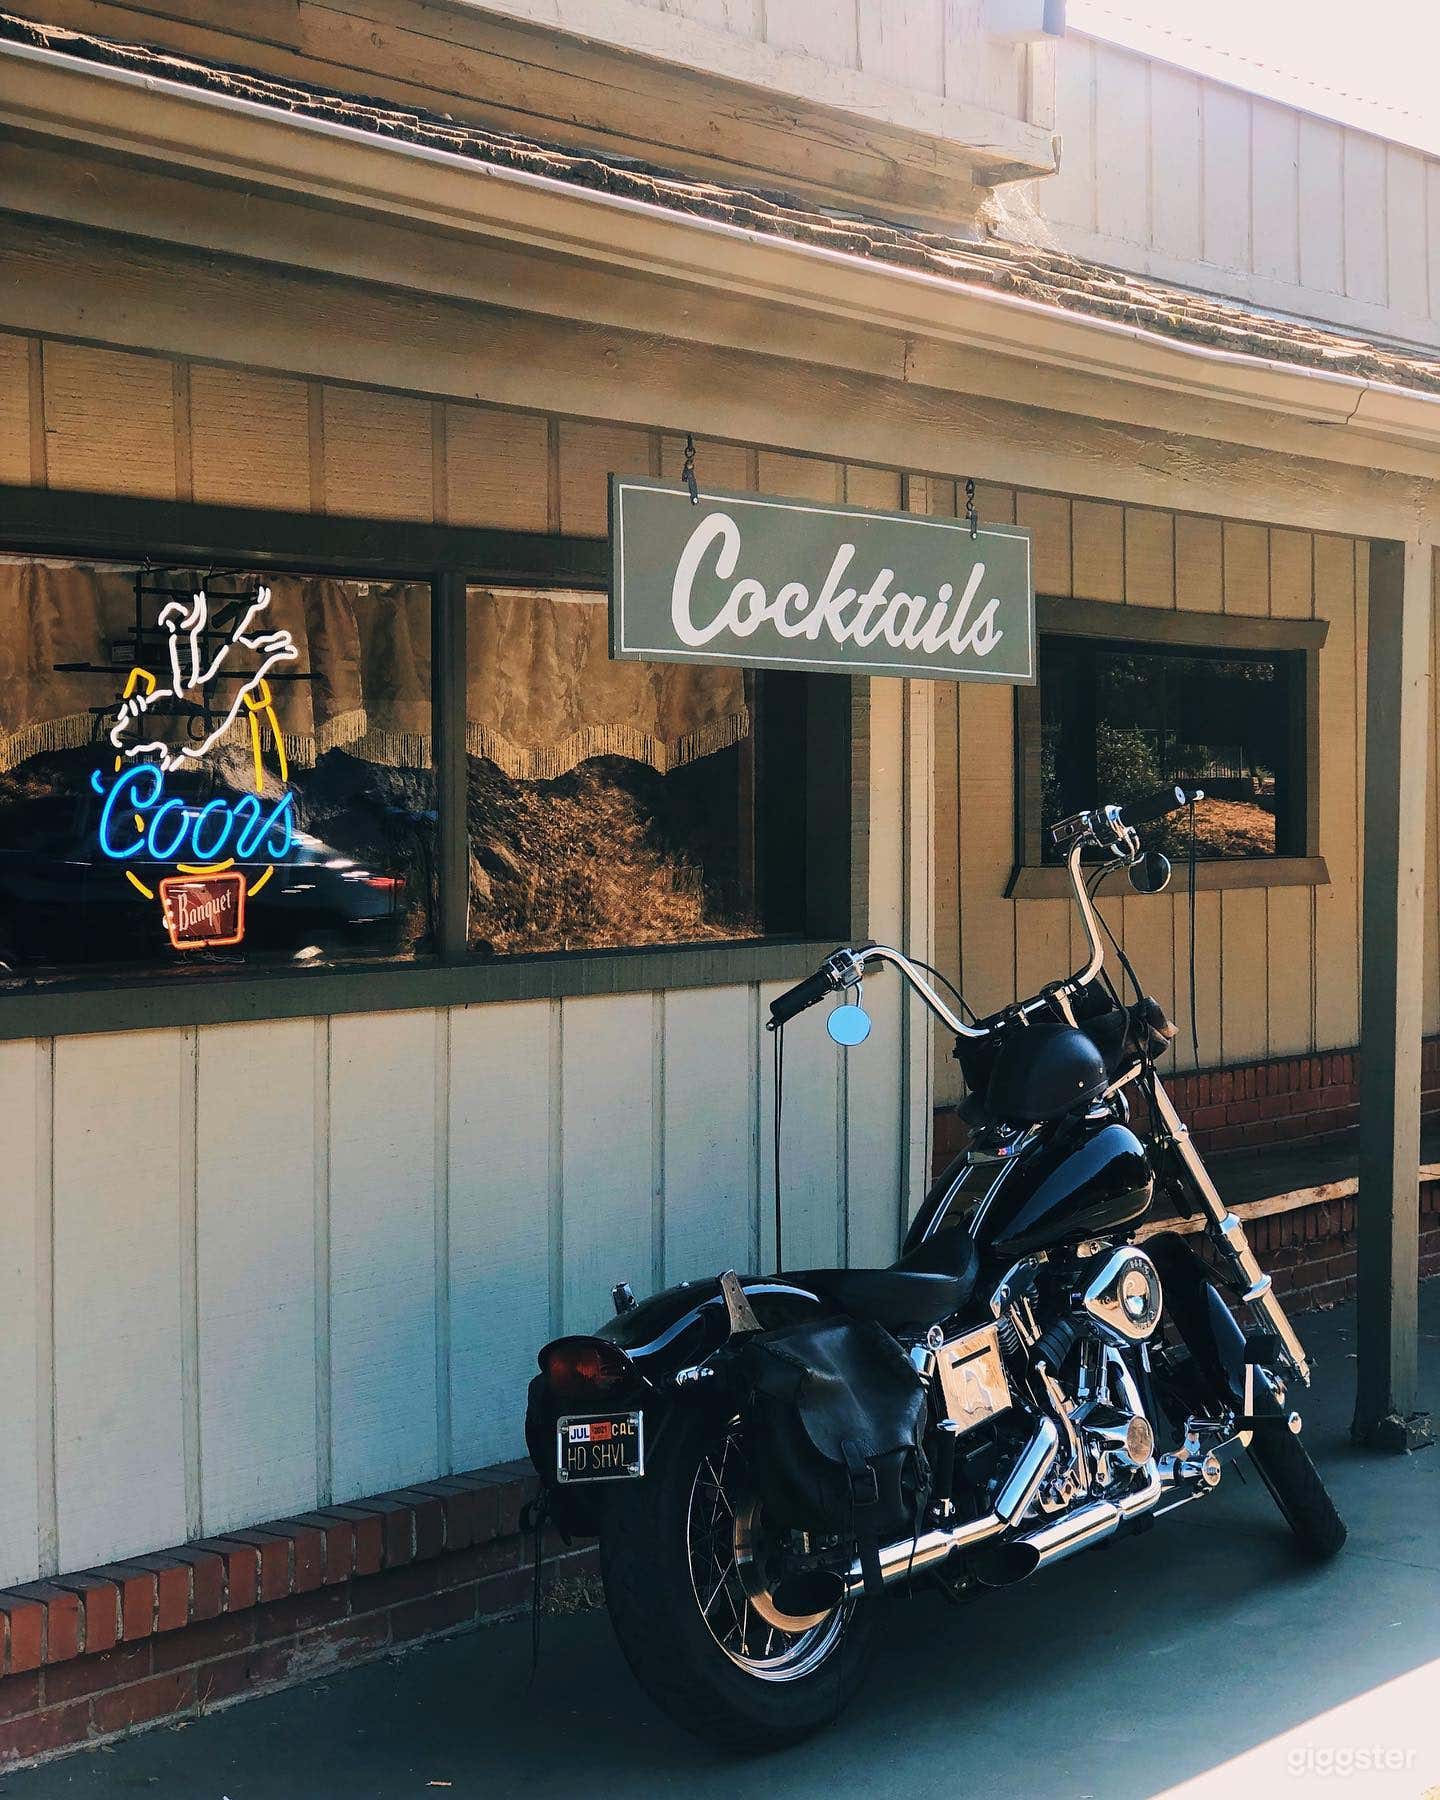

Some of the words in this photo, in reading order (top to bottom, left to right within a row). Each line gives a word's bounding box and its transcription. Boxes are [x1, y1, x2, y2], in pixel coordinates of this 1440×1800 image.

[671, 512, 1003, 656] Cocktails
[92, 763, 301, 859] Coors
[177, 889, 232, 932] Banquet
[570, 1427, 590, 1440] JUL
[611, 1422, 635, 1436] CAL
[592, 1443, 630, 1470] SHVL
